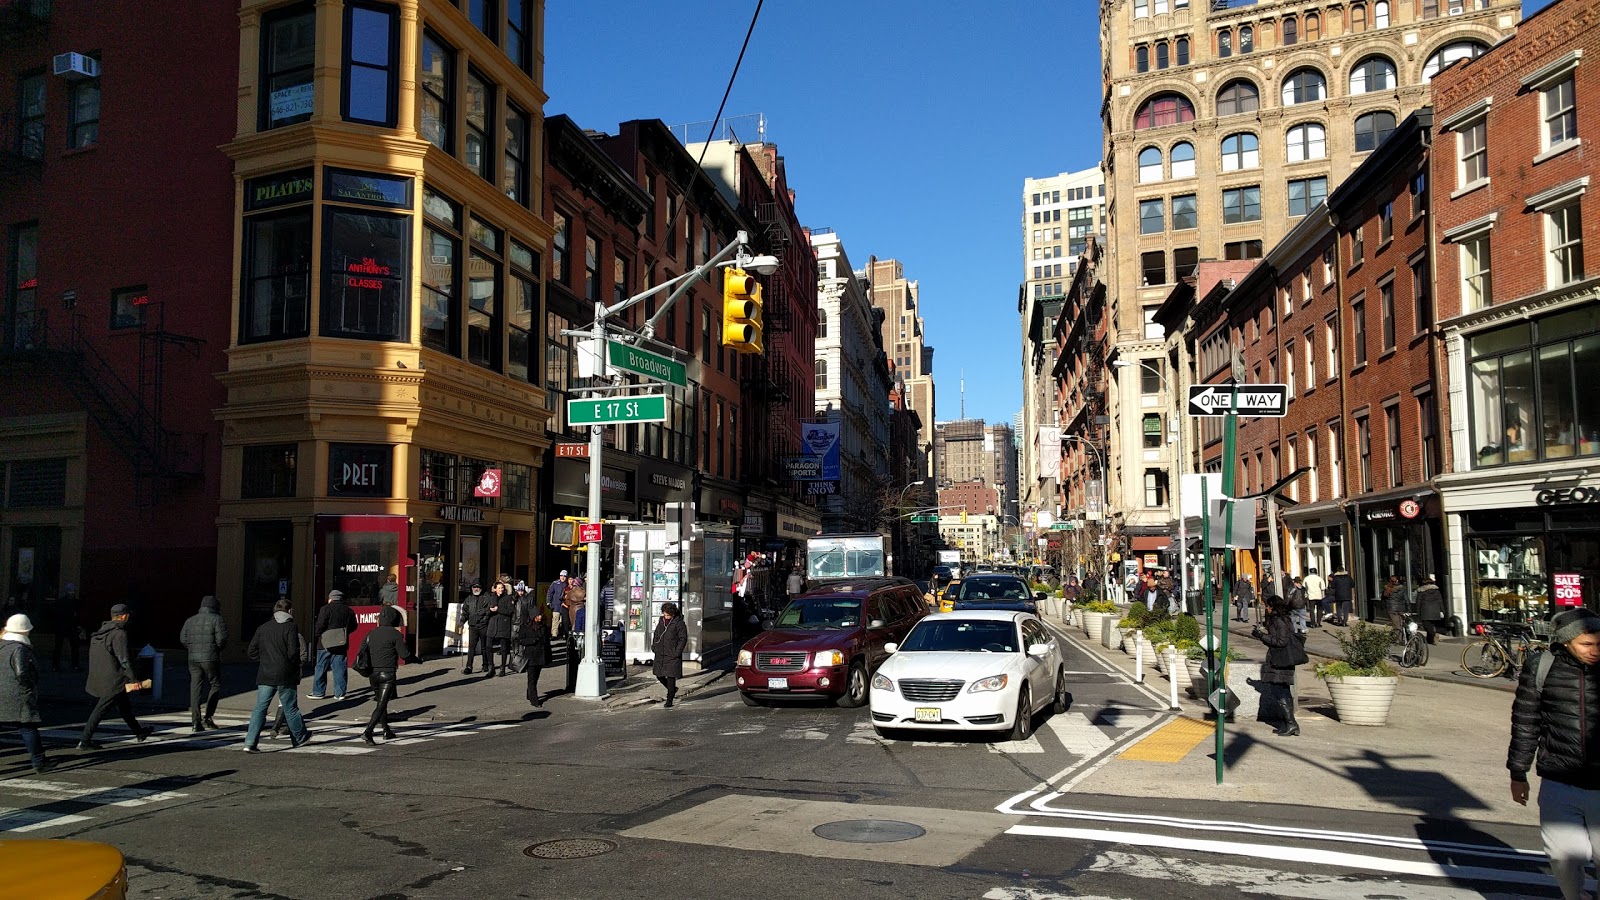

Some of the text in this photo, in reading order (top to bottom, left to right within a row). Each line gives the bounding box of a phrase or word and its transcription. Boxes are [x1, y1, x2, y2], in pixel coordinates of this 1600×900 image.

[274, 88, 291, 100] SPACE
[255, 177, 313, 201] PILATES
[362, 257, 377, 266] SAL
[348, 264, 390, 276] ANTHONY'S
[348, 277, 383, 289] CLASSES
[629, 351, 672, 379] Broadway
[1200, 394, 1277, 407] ONE WAY
[594, 401, 639, 419] E 17 St
[559, 446, 584, 456] E 17 St
[785, 462, 820, 470] PARAGON
[343, 462, 378, 486] PRET
[788, 469, 816, 477] SPORTS
[652, 473, 686, 490] STEVE MADDEN
[808, 480, 834, 488] THINK
[807, 487, 836, 495] SNOW
[1535, 487, 1600, 506] GEOX
[445, 506, 456, 520] PRET
[346, 564, 358, 573] PRET
[361, 564, 379, 573] MANGER
[1555, 577, 1581, 585] SALE
[360, 612, 380, 624] MANG
